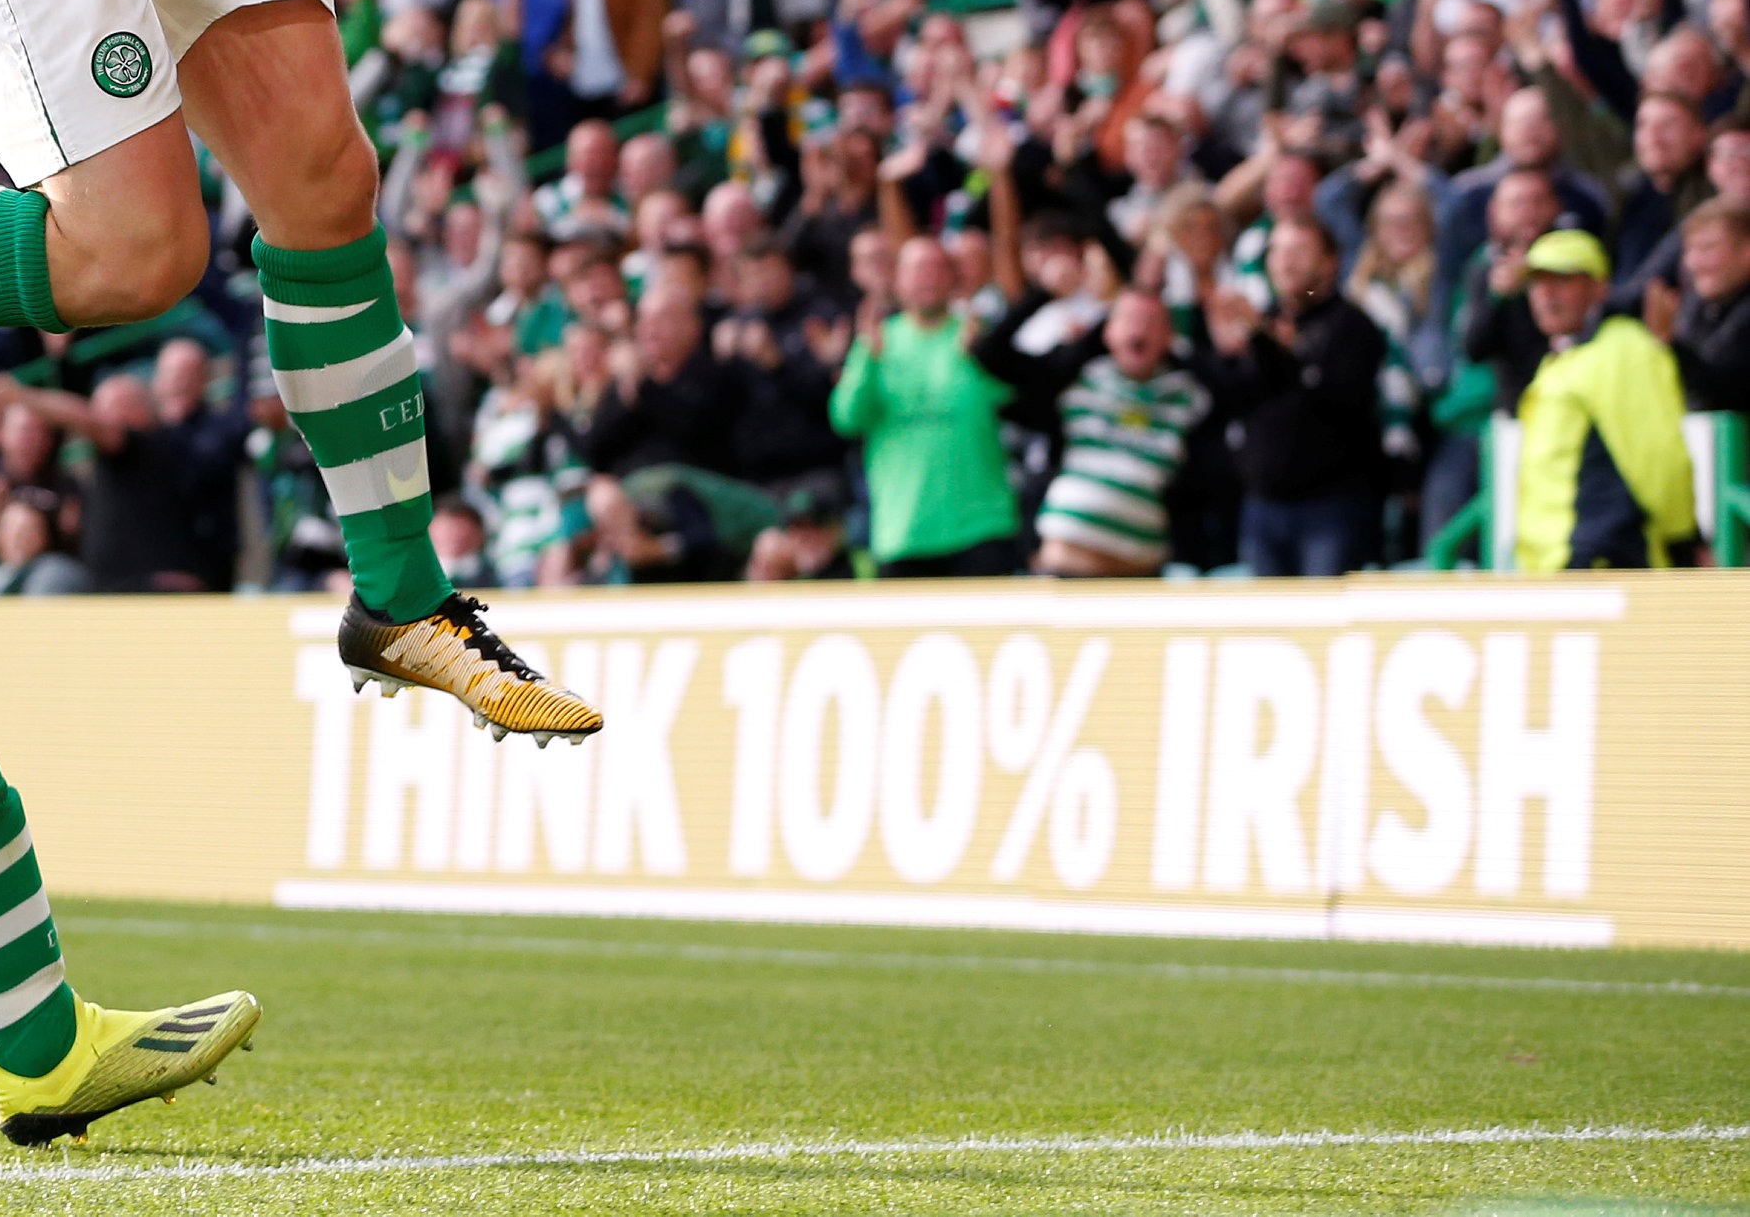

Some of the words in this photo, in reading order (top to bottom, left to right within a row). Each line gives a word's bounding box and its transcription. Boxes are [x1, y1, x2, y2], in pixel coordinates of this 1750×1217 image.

[96, 44, 109, 63] CELTIC
[107, 35, 136, 47] FOOTBALL
[135, 41, 146, 56] CLUB
[296, 636, 700, 877] THINK
[723, 631, 1118, 889] 100%
[1151, 629, 1600, 898] IRISH
